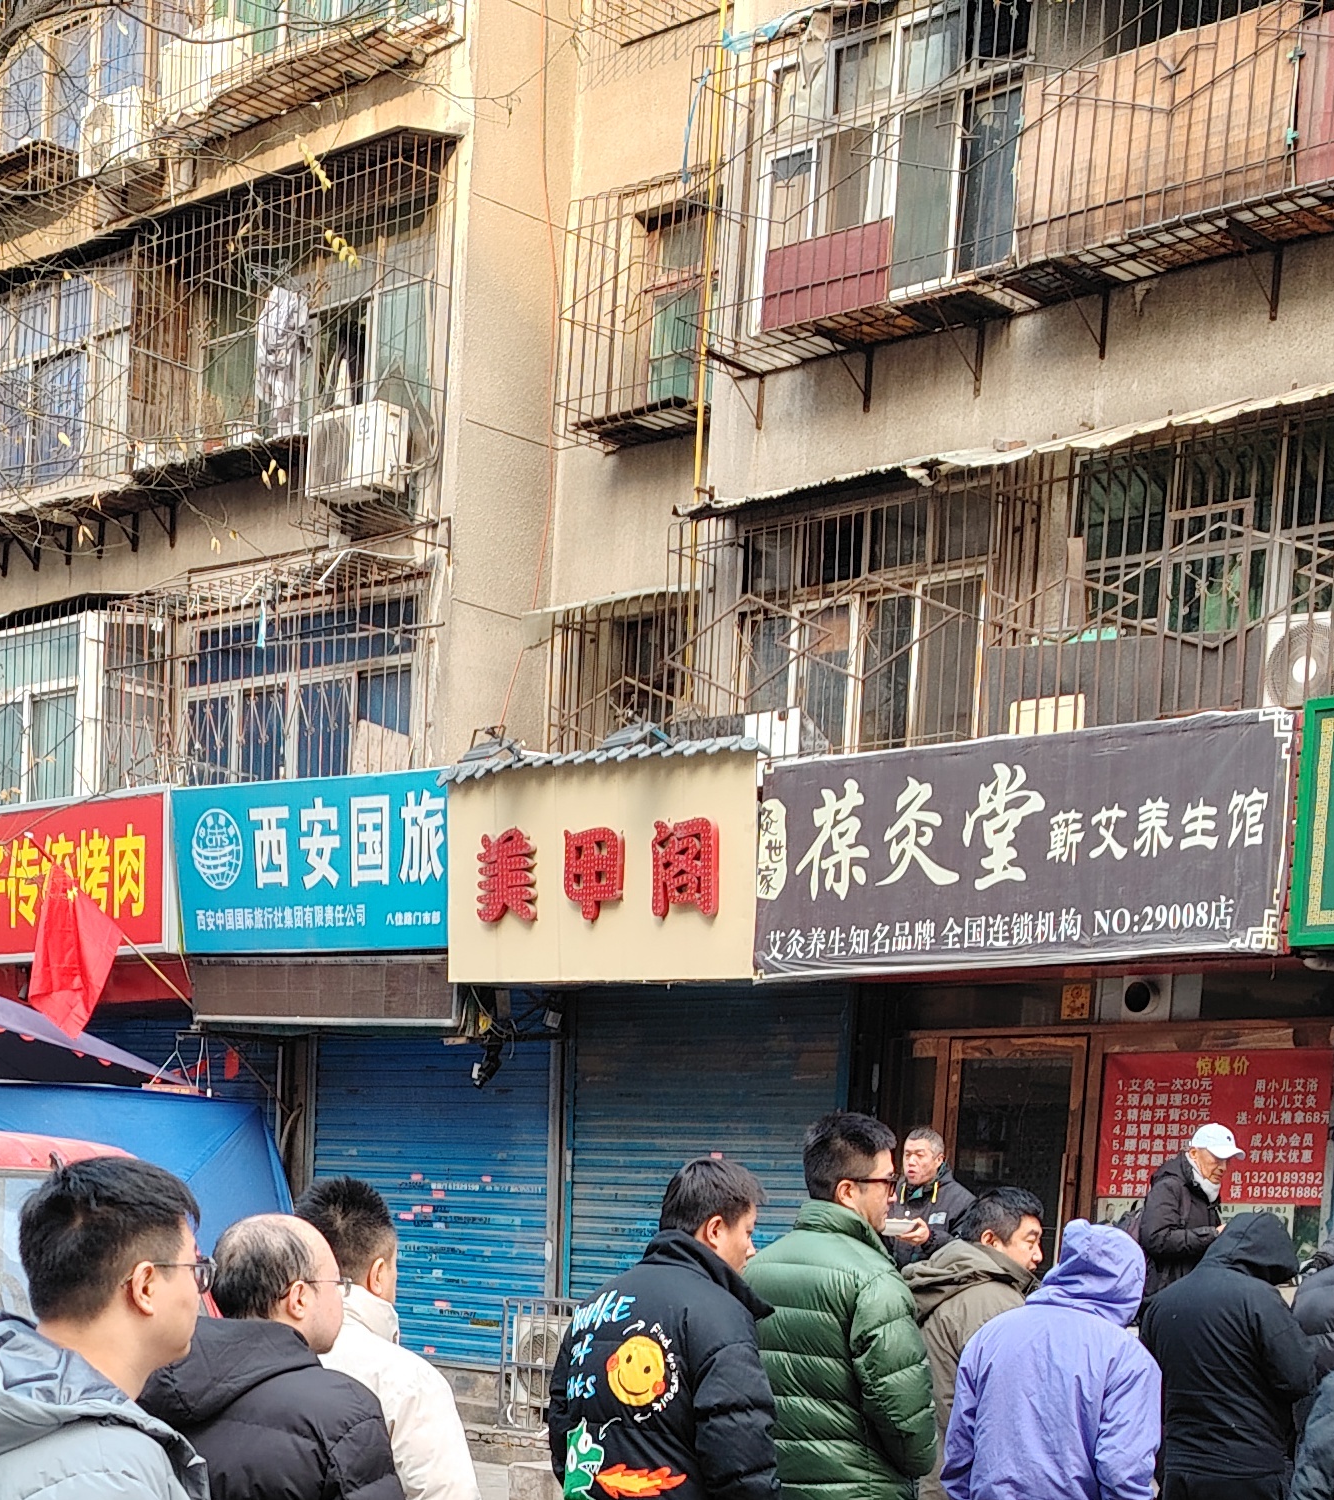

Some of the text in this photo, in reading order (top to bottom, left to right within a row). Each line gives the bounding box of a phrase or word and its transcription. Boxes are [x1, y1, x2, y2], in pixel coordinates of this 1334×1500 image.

[248, 789, 445, 889] 西安国旅
[795, 763, 1268, 901] 葆灸堂 蕲艾养生馆
[475, 816, 719, 924] 美甲阁
[196, 904, 366, 931] 西安中国国际旅行社集团有限责任公司
[765, 895, 1235, 960] 艾灸养生知名品牌 全国连锁机构 NO:29008店
[1196, 1056, 1250, 1077] 惊爆价
[1117, 1077, 1213, 1092] 1.艾灸一次30元
[1114, 1109, 1210, 1122] 3.精油开背30元
[1113, 1124, 1202, 1137] 4.肠胃调理30
[1250, 1134, 1314, 1147] 成人办会员
[1249, 1150, 1313, 1163] 有特大优惠
[1109, 1183, 1151, 1197] 8.前列
